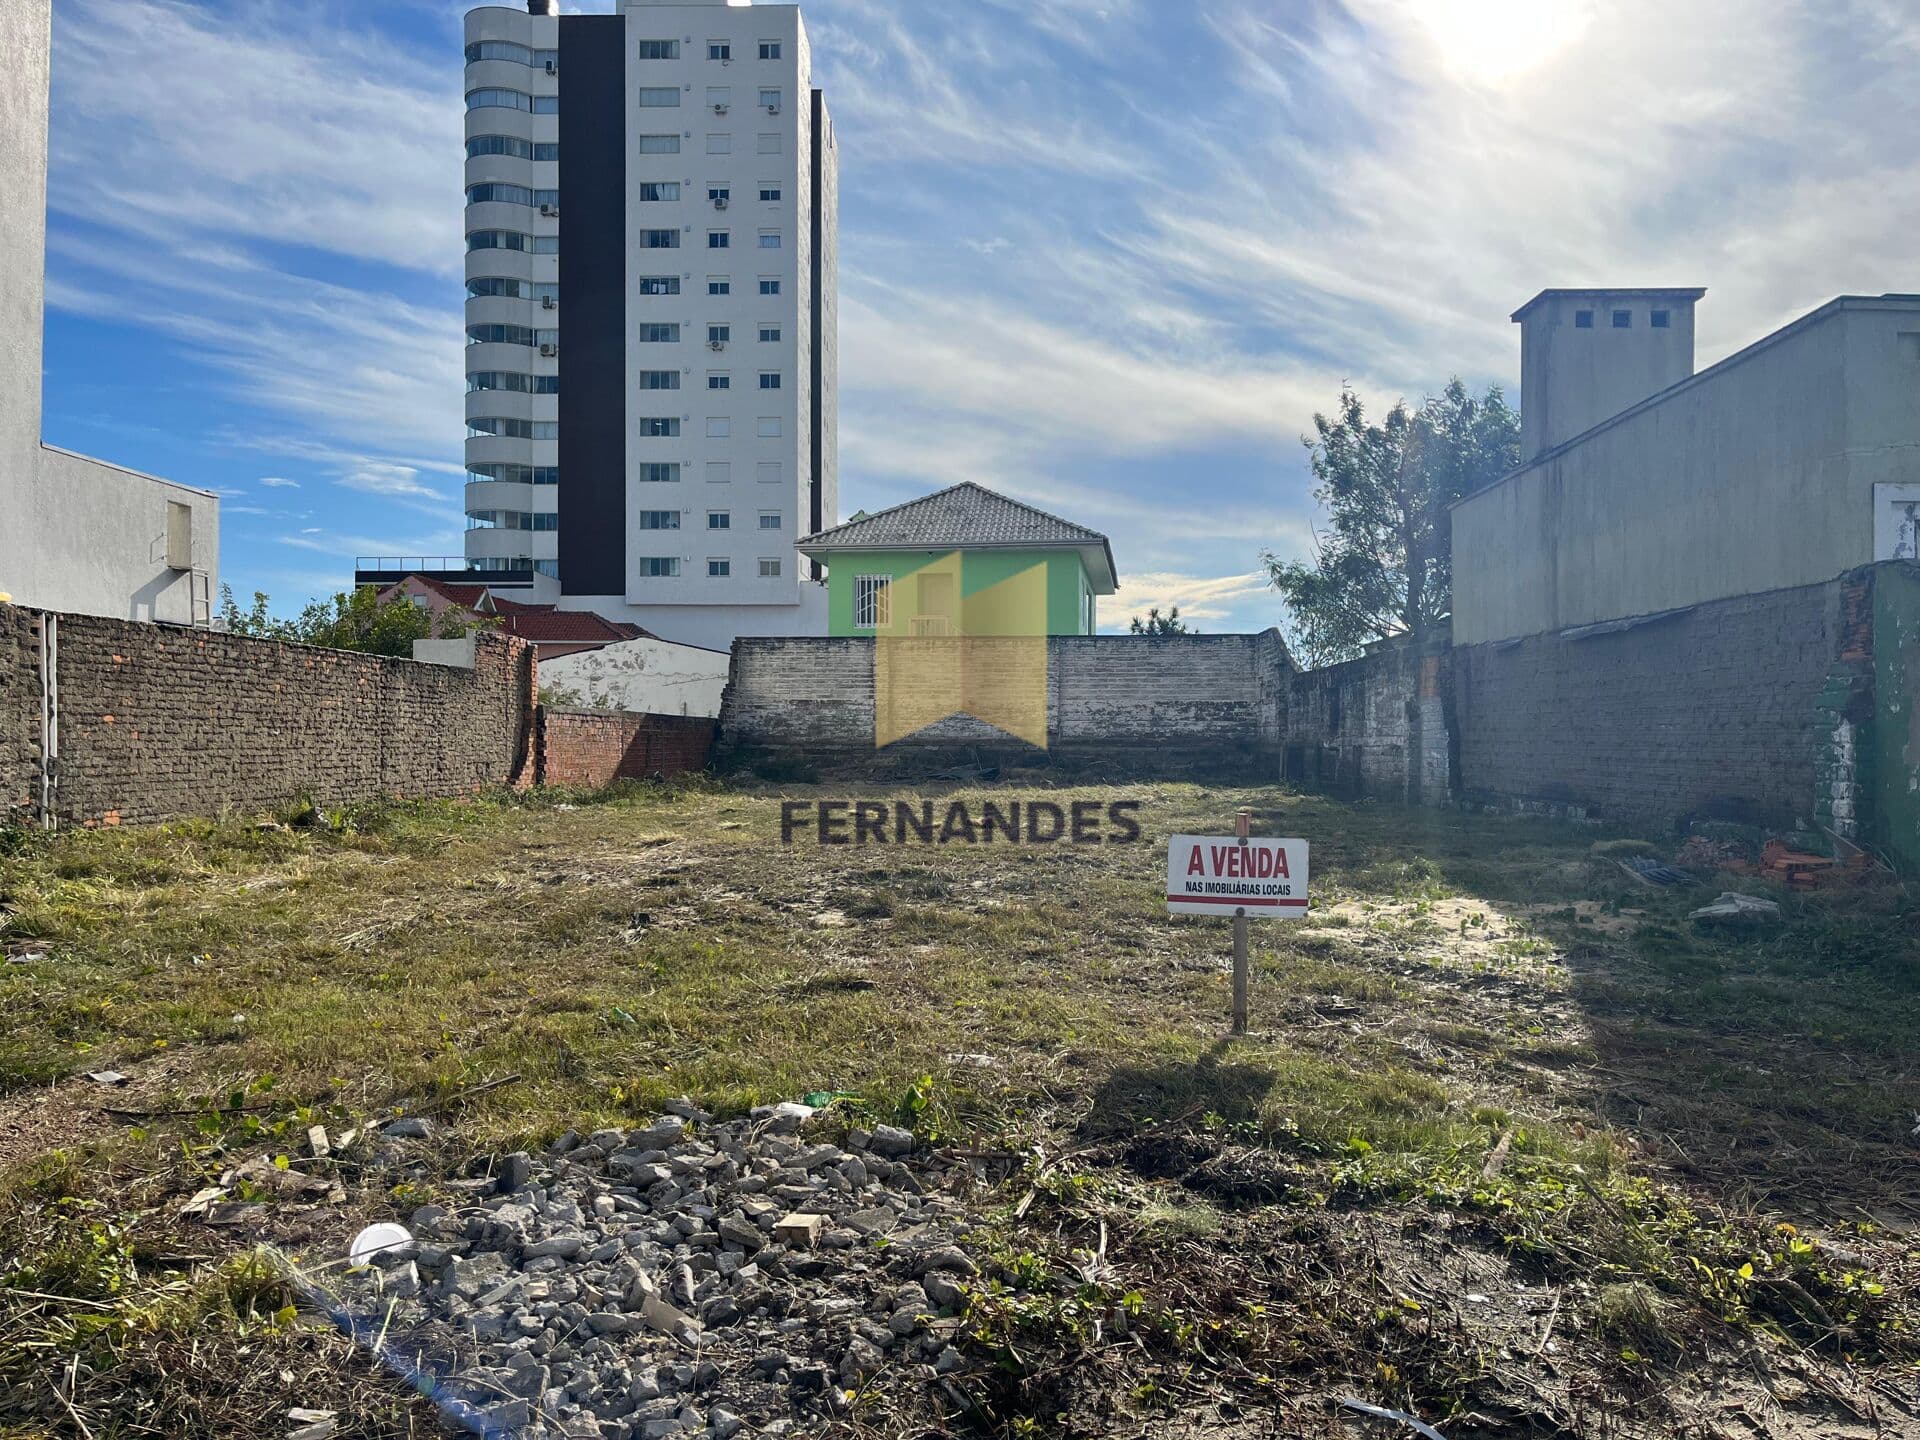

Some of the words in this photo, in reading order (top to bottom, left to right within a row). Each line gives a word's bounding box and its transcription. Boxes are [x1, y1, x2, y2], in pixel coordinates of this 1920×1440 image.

[1187, 844, 1205, 876] A
[1211, 845, 1290, 879] VENDA
[1185, 881, 1203, 893] NAS
[1205, 881, 1260, 895] IMOBILIÁRIAS
[1262, 884, 1291, 896] LOCAIS
